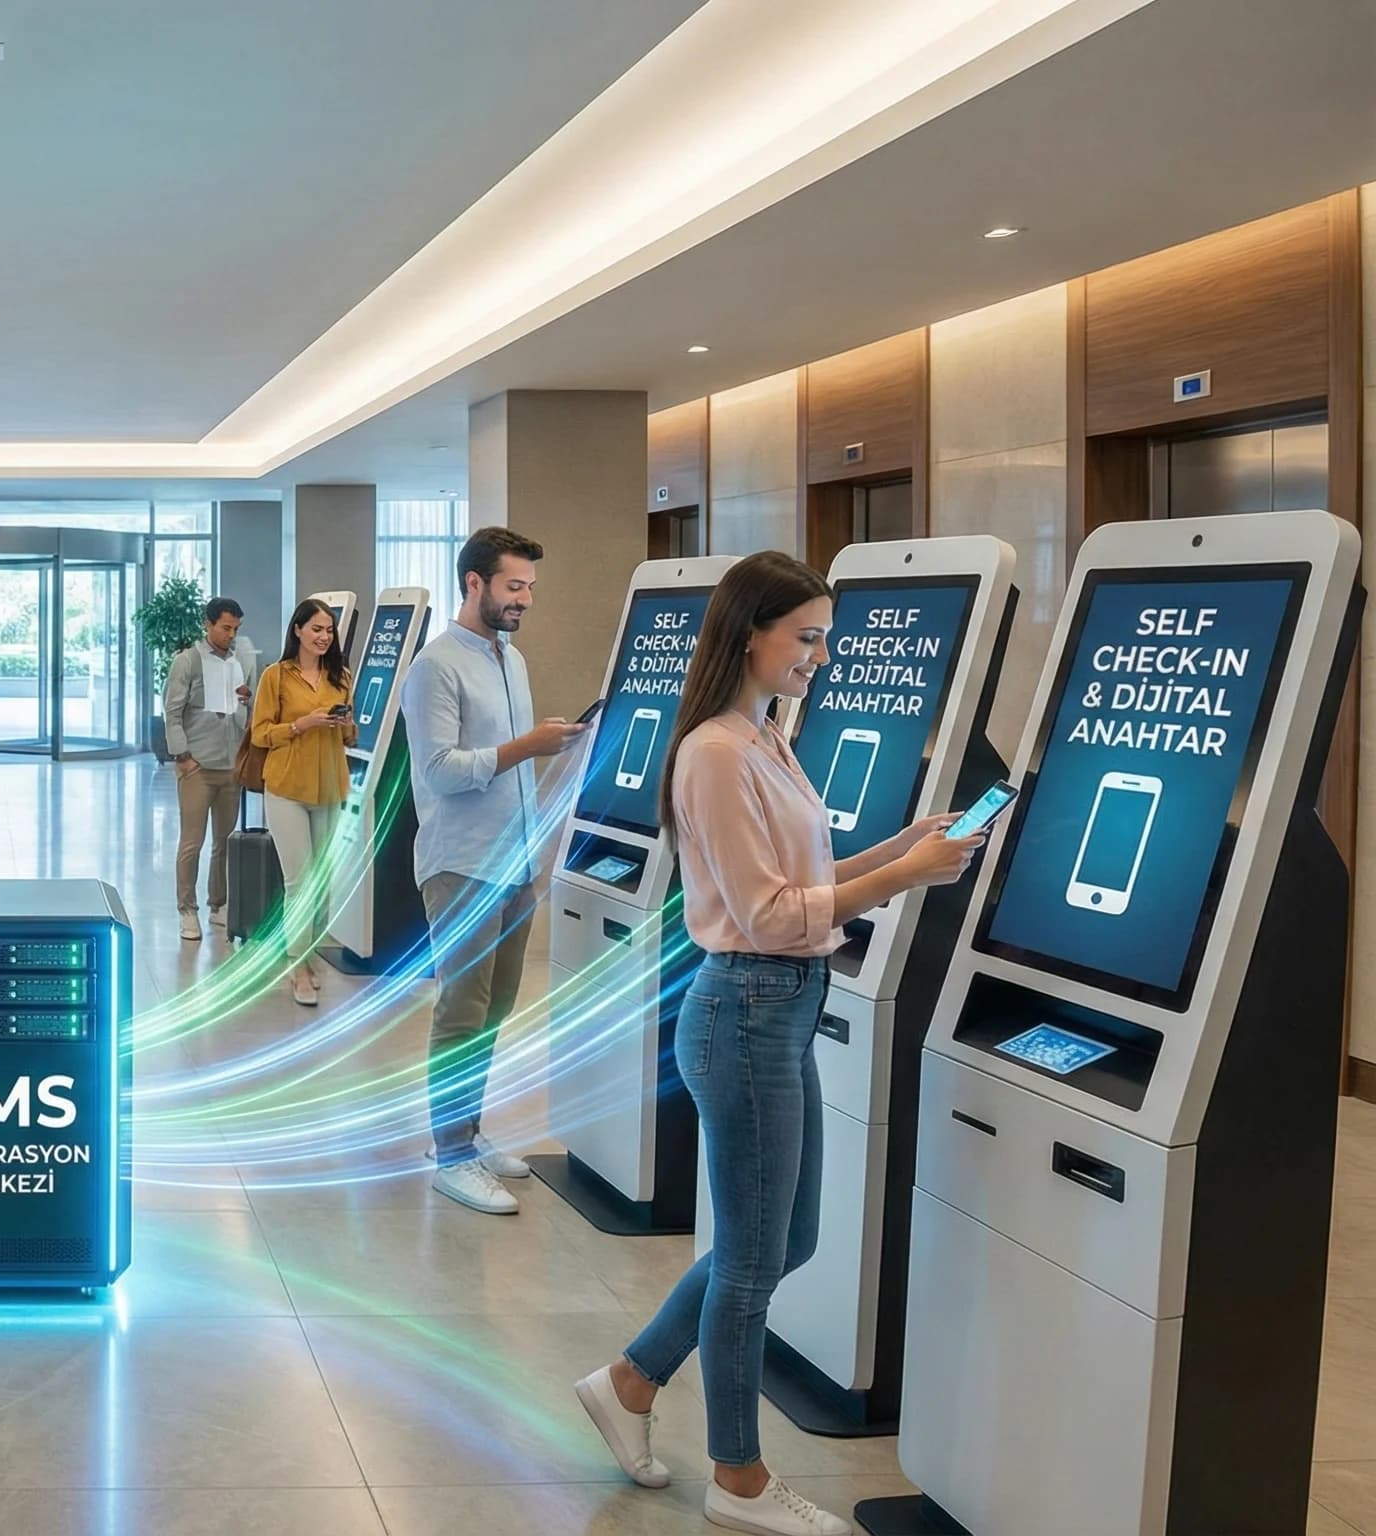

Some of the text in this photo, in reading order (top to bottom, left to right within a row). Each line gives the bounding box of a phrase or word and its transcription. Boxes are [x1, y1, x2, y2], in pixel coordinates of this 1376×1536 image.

[653, 612, 691, 629] SELF
[866, 608, 921, 629] SELF
[1135, 608, 1218, 636] SELF
[837, 636, 941, 658] CHECK-IN
[627, 656, 638, 672] &
[829, 659, 927, 687] & DİJİTAL
[1092, 645, 1250, 677] CHECK-IN
[819, 690, 923, 716] ANAHTAR
[1081, 676, 1232, 717] & DİJİTAL
[1067, 717, 1228, 757] ANAHTAR
